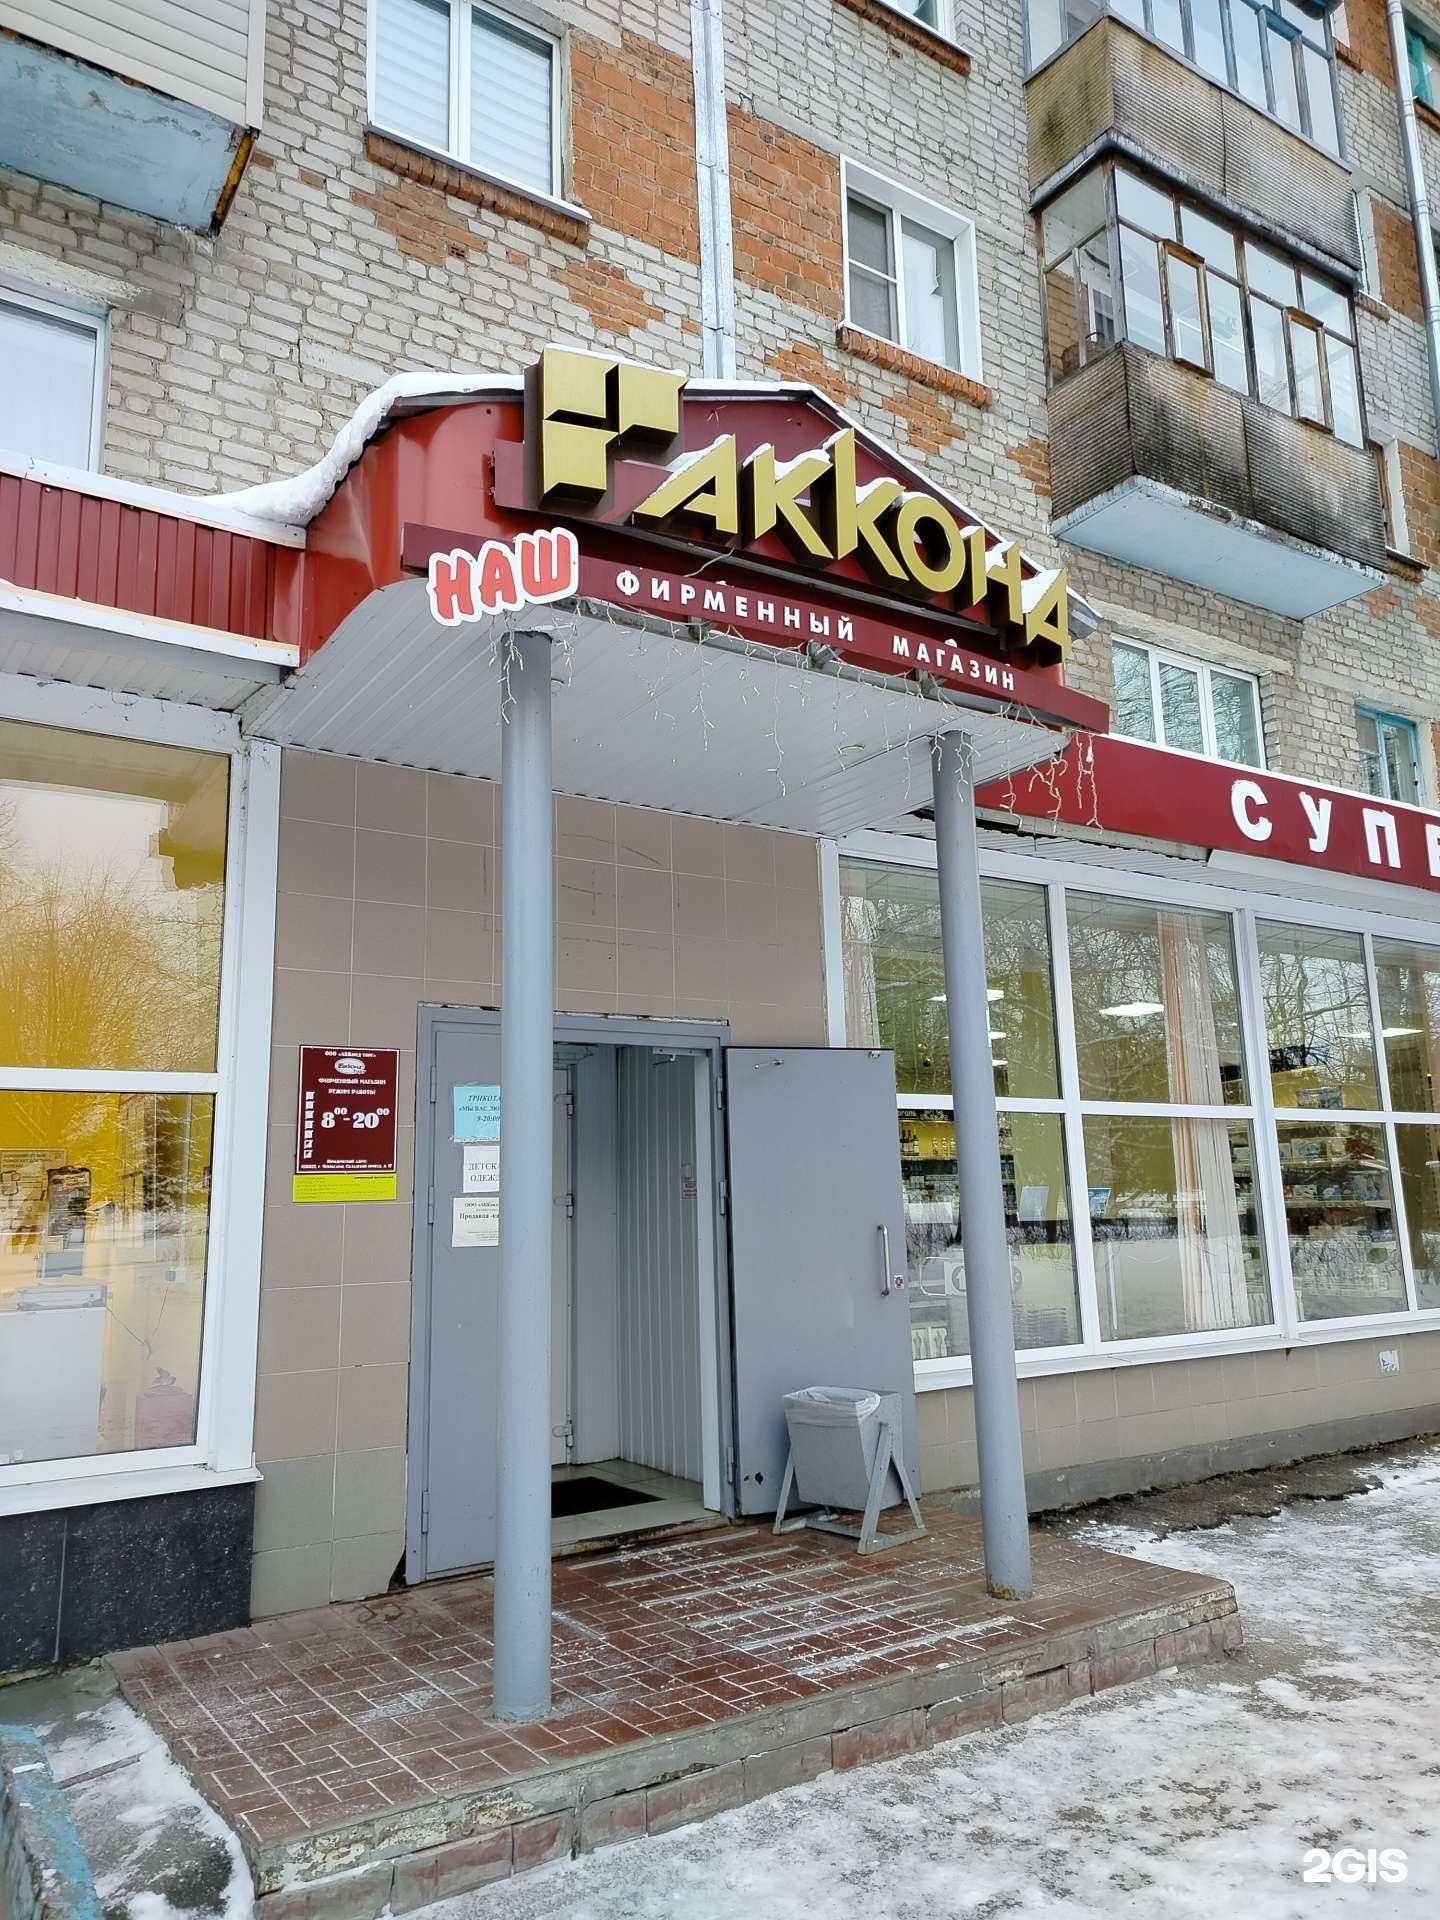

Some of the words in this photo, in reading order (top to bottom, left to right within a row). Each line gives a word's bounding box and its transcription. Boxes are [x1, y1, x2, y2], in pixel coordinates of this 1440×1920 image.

[431, 530, 575, 623] НАШ
[615, 569, 854, 643] ФИРМЕННЫЙ
[892, 635, 1015, 691] МАГАЗИН
